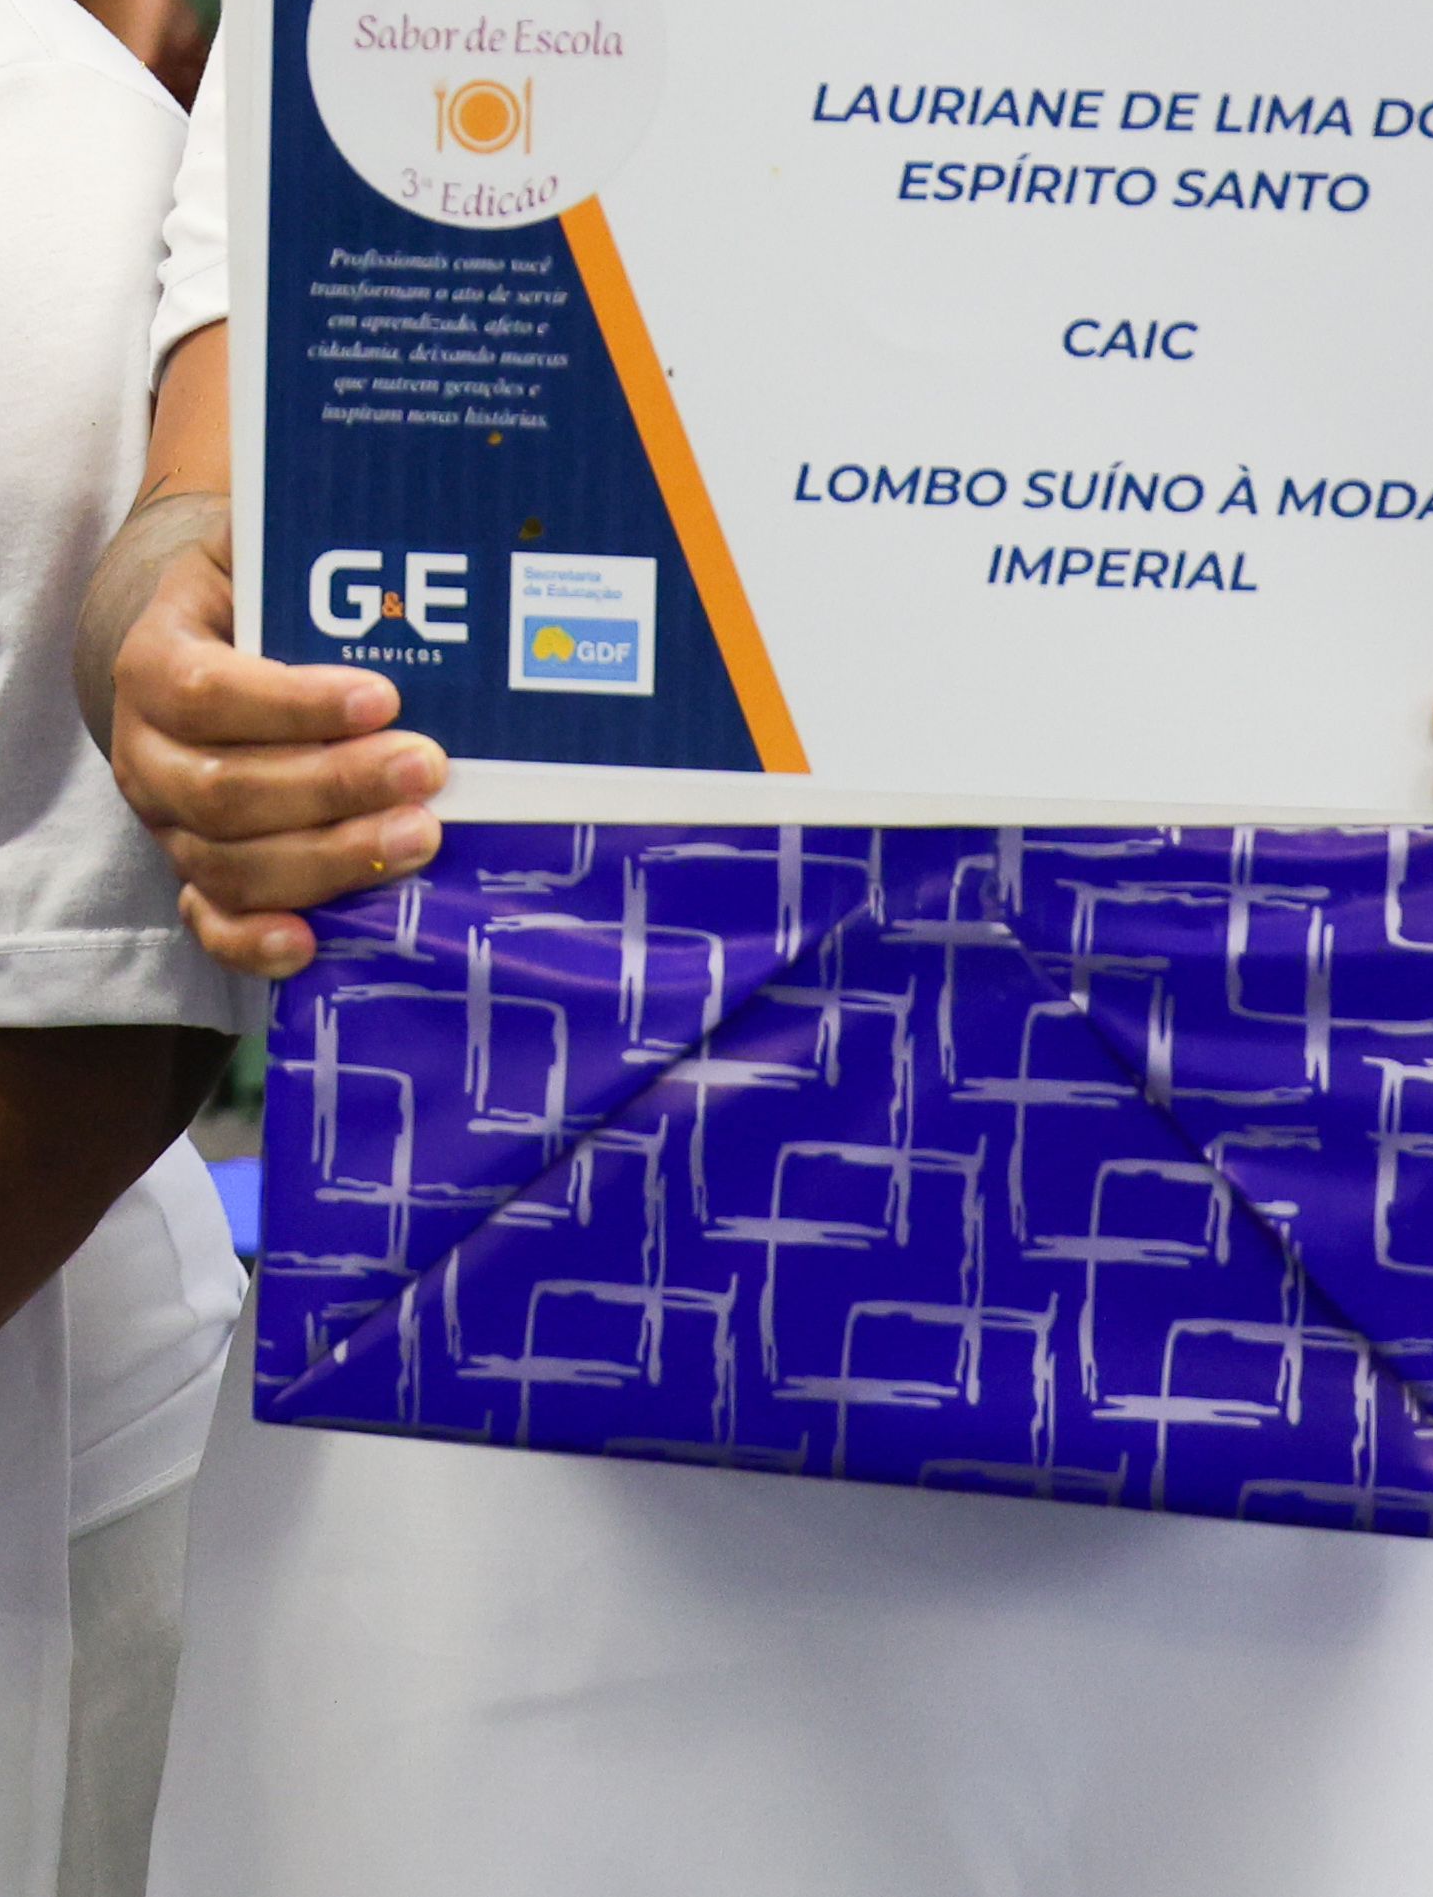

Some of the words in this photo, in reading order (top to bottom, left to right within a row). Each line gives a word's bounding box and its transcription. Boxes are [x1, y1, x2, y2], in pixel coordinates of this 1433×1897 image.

[354, 12, 460, 52] Sabor
[464, 15, 508, 54] de
[514, 18, 624, 57] Escola
[812, 82, 1105, 129] LAURIANE
[1119, 91, 1200, 132] DE
[1214, 93, 1353, 137] LIMA
[897, 153, 1157, 207] ESPÍRITO
[1172, 169, 1371, 213] SANTO
[453, 257, 506, 273] como
[435, 288, 449, 302] o
[451, 286, 484, 303] ato
[487, 283, 512, 303] de
[1062, 318, 1199, 361] CAIC
[794, 462, 1008, 508] LOMBO
[1022, 461, 1205, 513] SUÍNO
[1217, 465, 1258, 516] À
[987, 544, 1258, 592] IMPERIAL
[308, 548, 469, 643] G&E
[341, 644, 443, 665] SERVIÇOS
[576, 639, 632, 664] GDF
